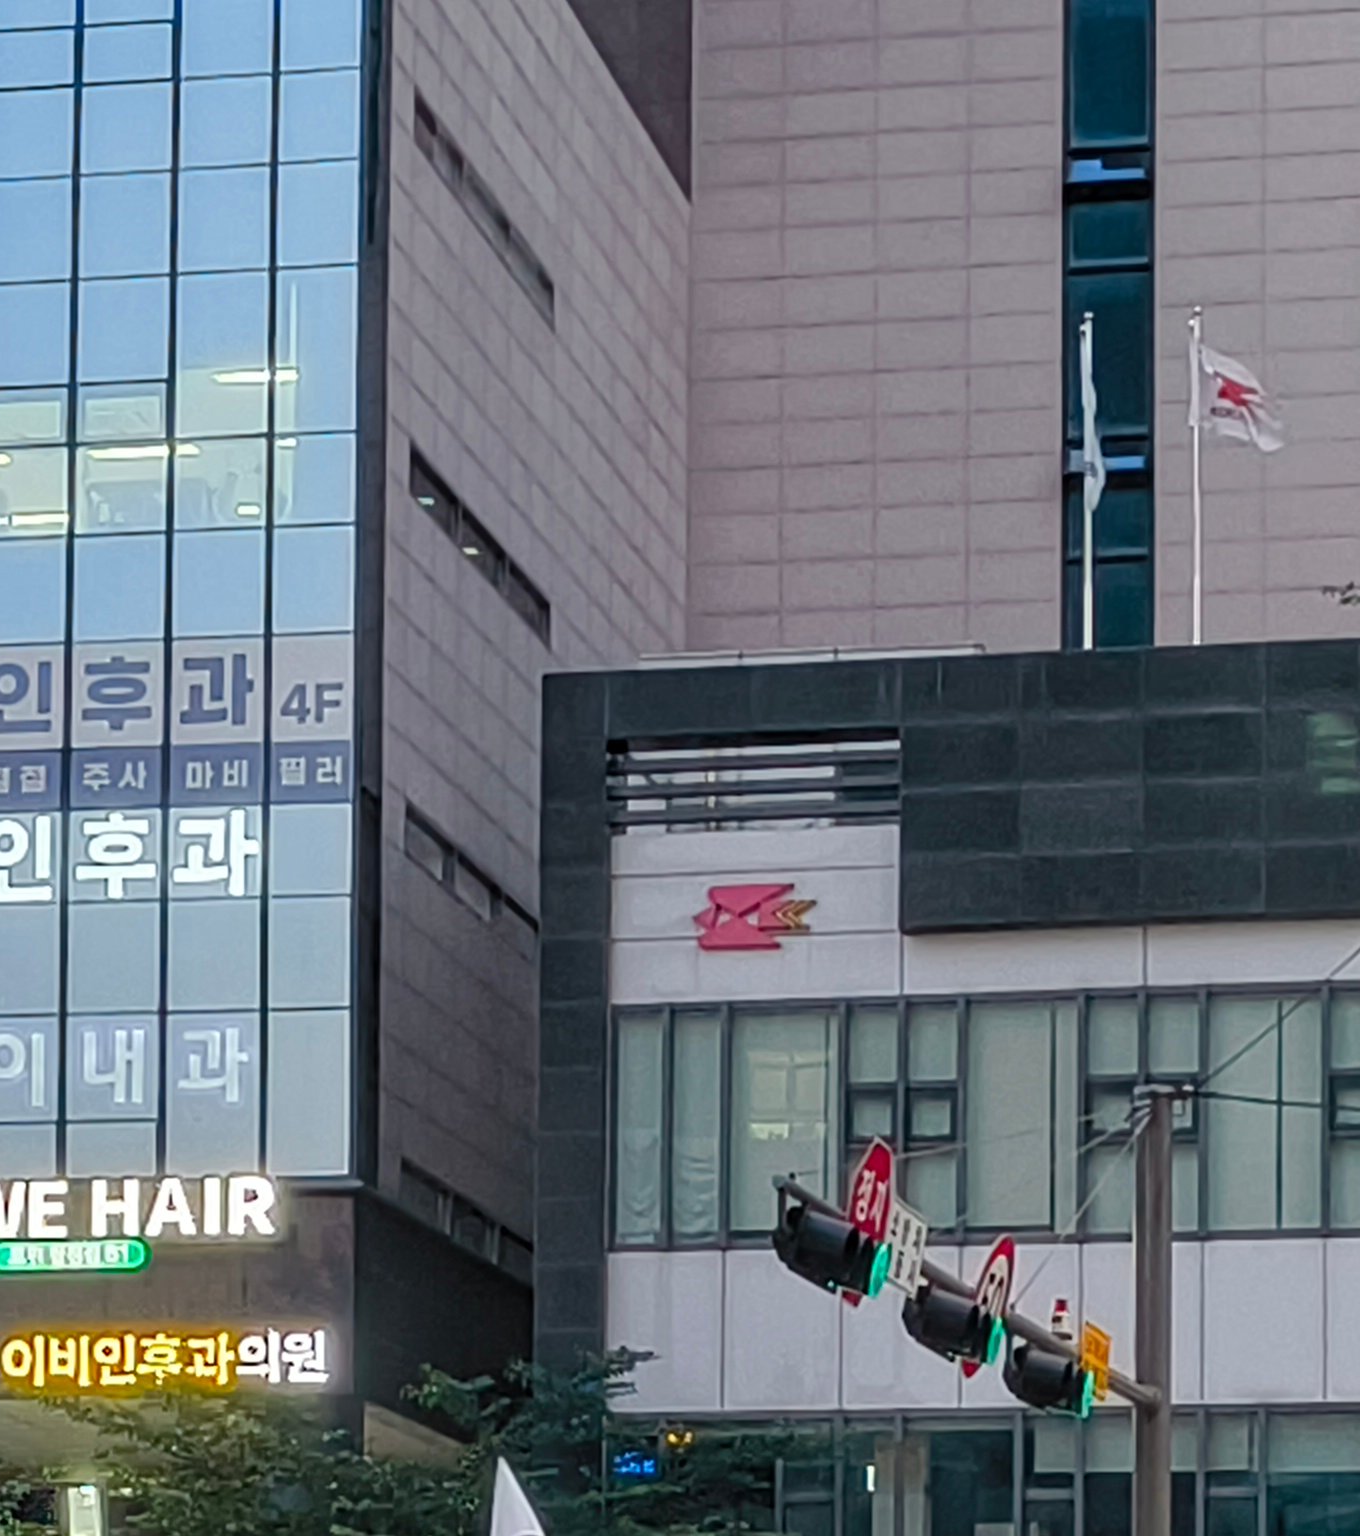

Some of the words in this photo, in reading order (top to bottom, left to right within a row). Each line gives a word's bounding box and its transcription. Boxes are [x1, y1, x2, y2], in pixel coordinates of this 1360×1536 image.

[280, 683, 344, 724] 4F
[82, 761, 147, 791] 주사
[186, 759, 249, 790] 마비
[91, 1174, 278, 1238] HAIR
[855, 1169, 888, 1233] 정지
